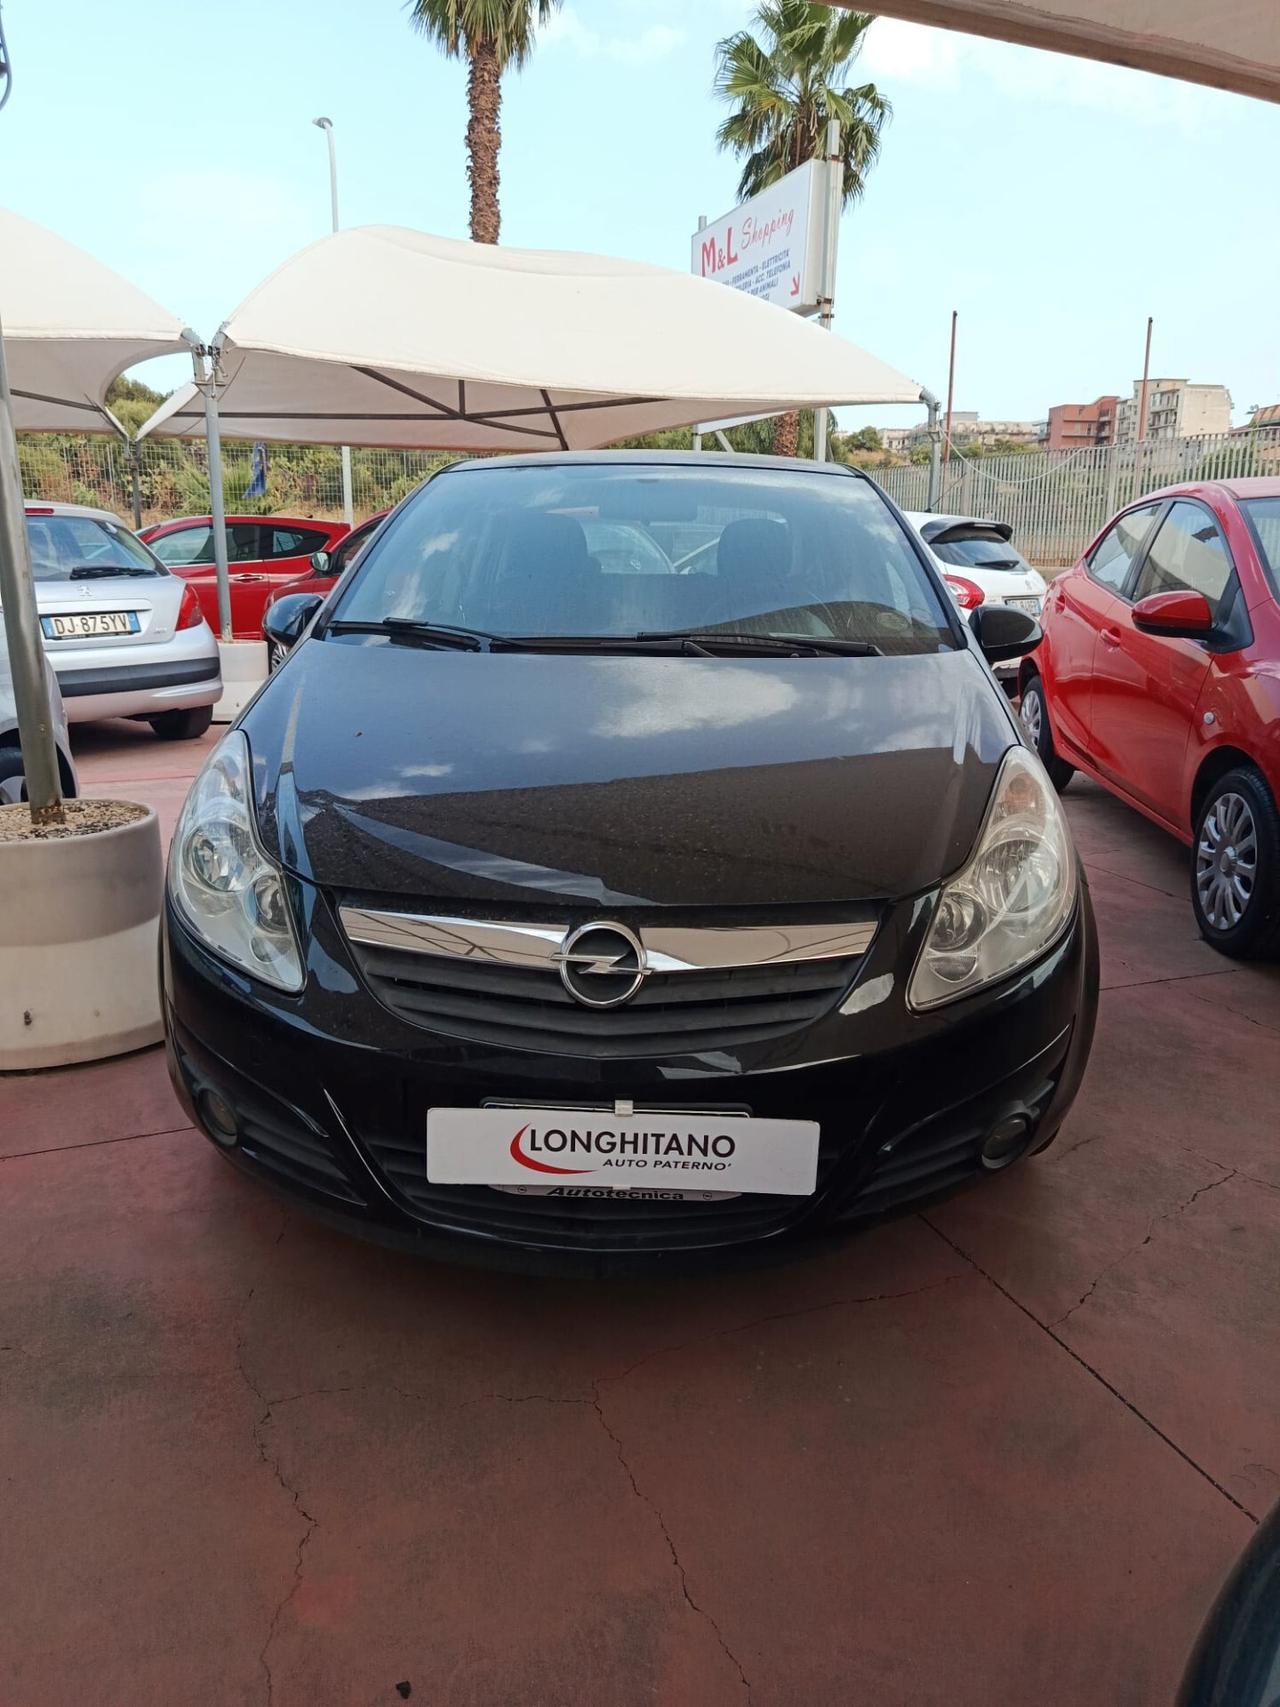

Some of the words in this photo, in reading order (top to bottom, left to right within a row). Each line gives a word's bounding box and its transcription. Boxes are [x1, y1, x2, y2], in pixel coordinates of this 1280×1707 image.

[702, 227, 738, 277] M&L
[741, 209, 794, 250] Shopping
[54, 618, 75, 635] DJ
[80, 614, 127, 633] 875YV
[530, 1128, 736, 1158] LONGHITANO
[603, 1158, 648, 1169] AUTO
[653, 1159, 731, 1172] PATERNO'
[545, 1187, 685, 1201] Autotecnica
